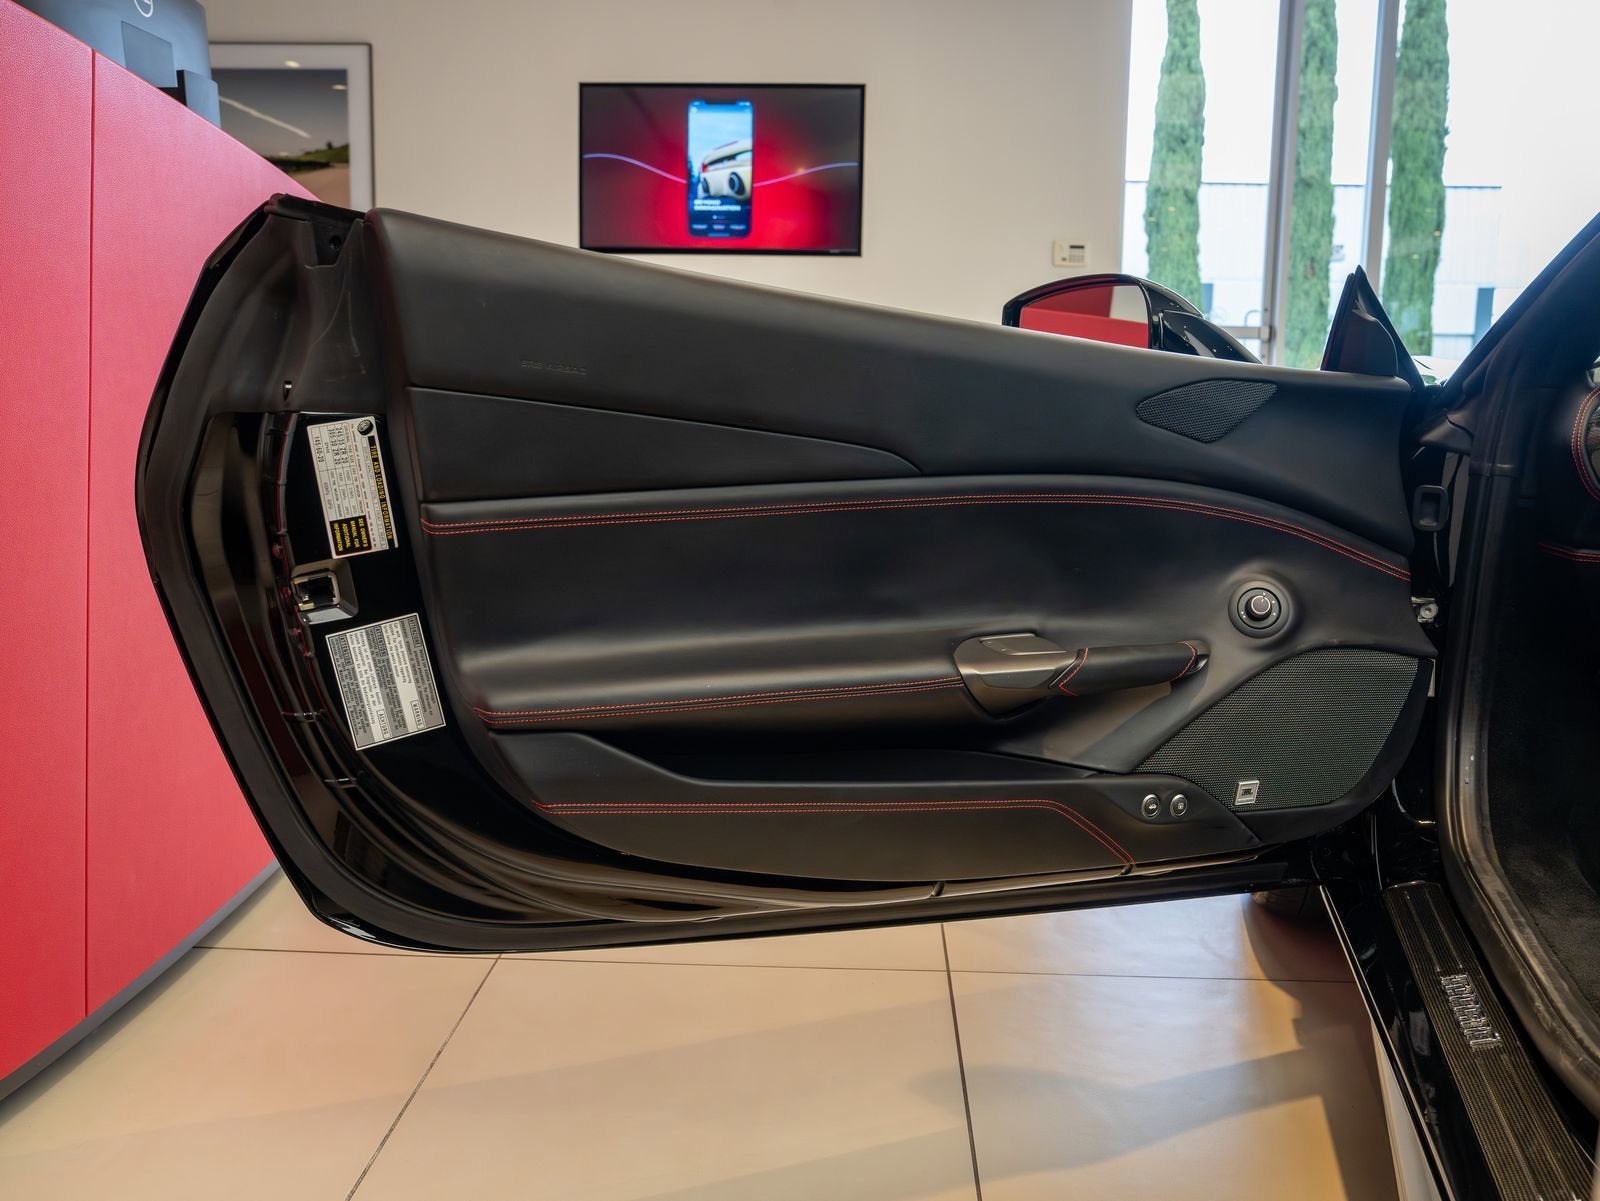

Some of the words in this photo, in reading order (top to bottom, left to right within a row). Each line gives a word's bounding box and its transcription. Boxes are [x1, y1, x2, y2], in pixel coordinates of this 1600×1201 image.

[369, 445, 378, 458] TIRE
[372, 461, 380, 472] AND
[375, 473, 385, 499] LOADING
[380, 500, 393, 539] INFORMATION
